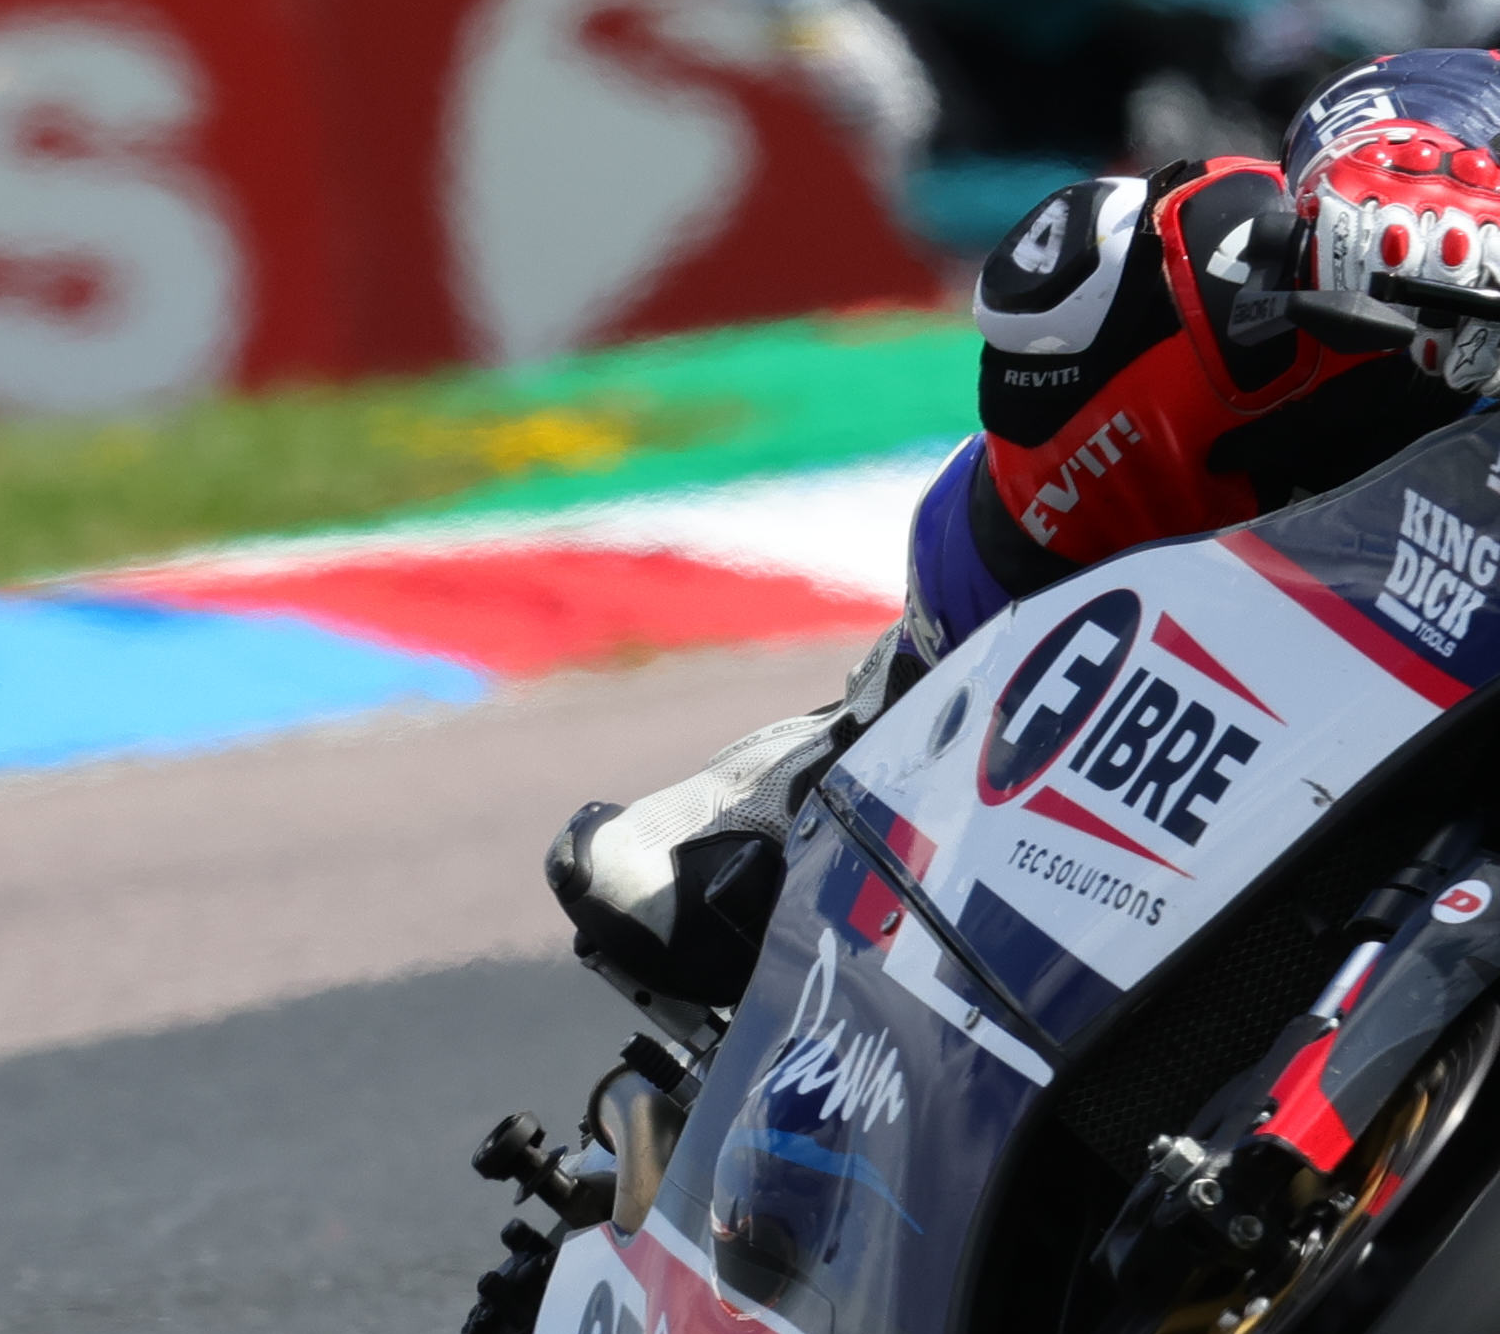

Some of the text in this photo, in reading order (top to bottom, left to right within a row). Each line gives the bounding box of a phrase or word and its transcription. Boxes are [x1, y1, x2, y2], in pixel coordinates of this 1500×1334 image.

[1004, 366, 1080, 387] REV'IT!
[1020, 410, 1142, 548] EV'IT!
[1384, 539, 1486, 640] DICK
[1416, 622, 1457, 658] TOOLS
[1001, 620, 1261, 847] FIBRE
[1008, 839, 1048, 875] TEC
